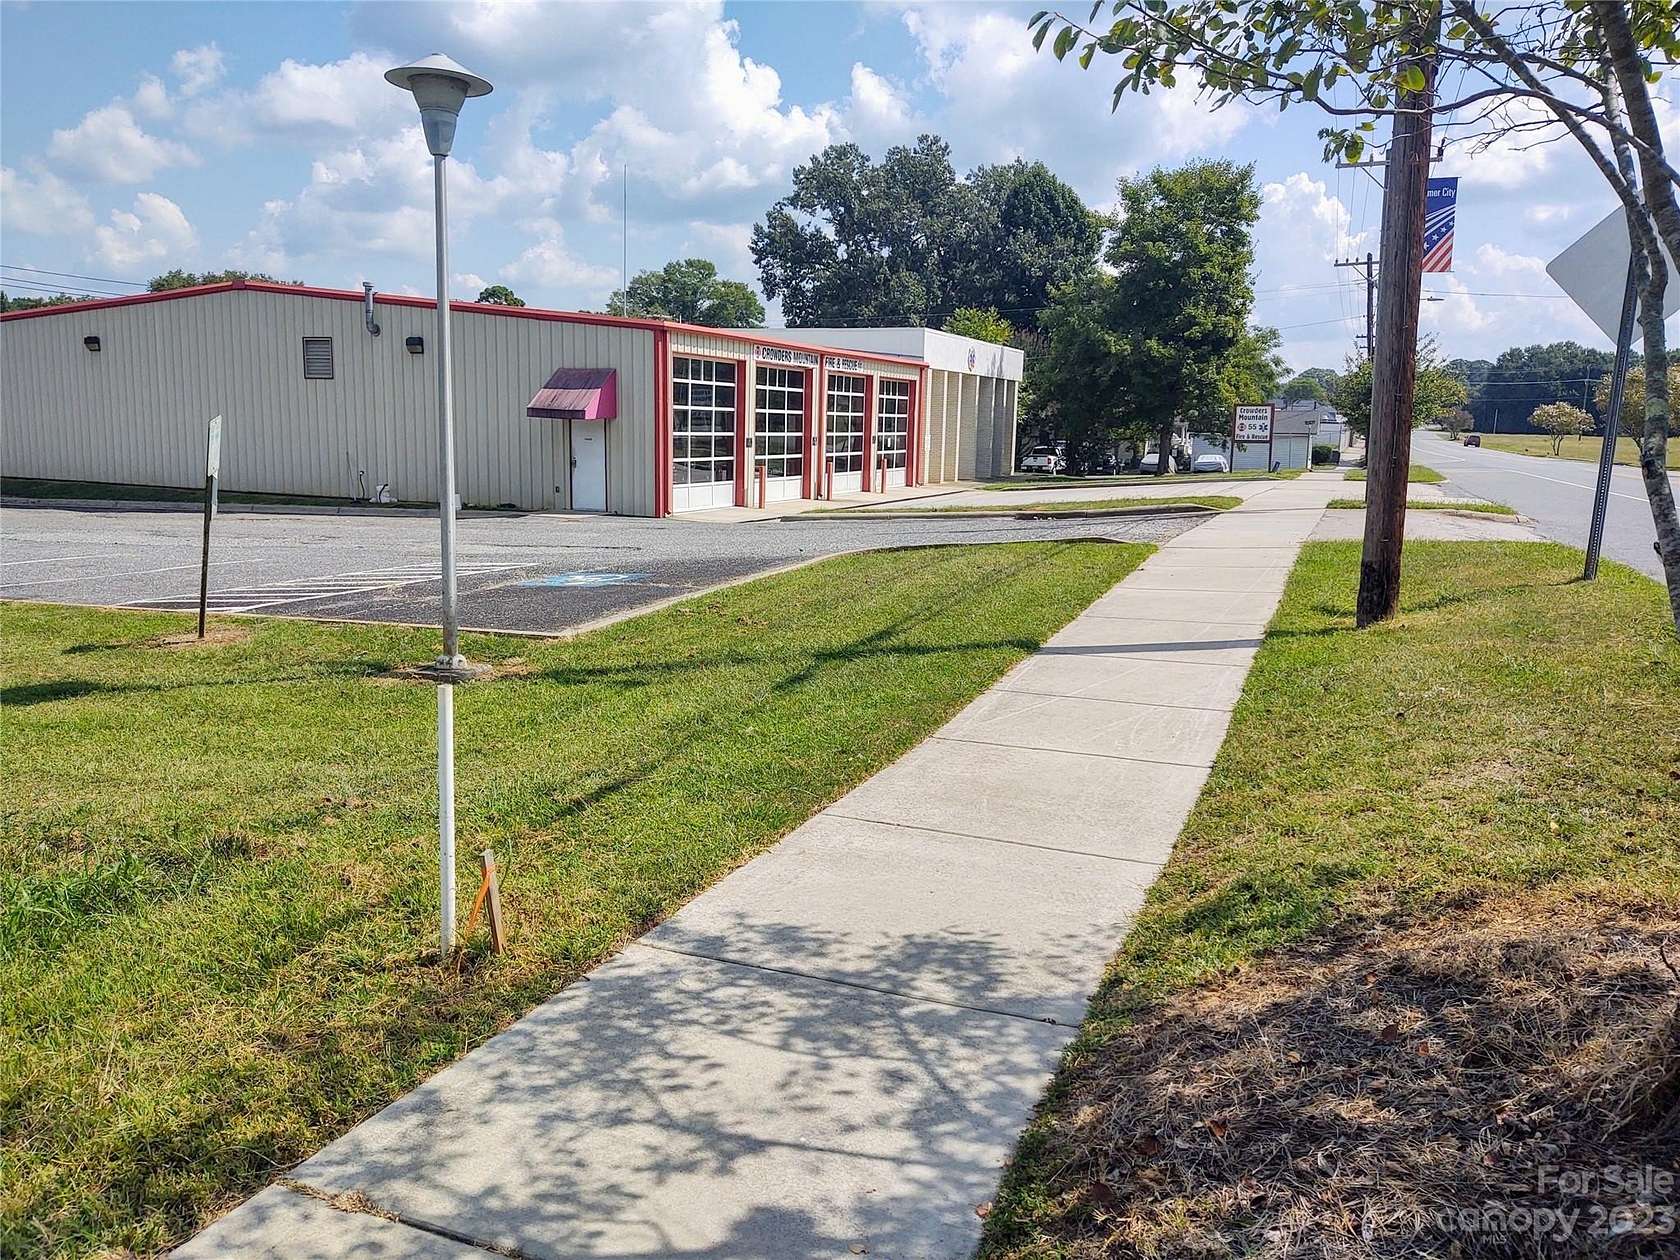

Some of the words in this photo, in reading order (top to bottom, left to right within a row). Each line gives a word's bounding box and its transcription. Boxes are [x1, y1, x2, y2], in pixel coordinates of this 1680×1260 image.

[1442, 187, 1456, 198] City
[762, 347, 792, 362] CROWDERS
[793, 352, 818, 365] MOUNTAIN
[825, 357, 835, 369] FIRE
